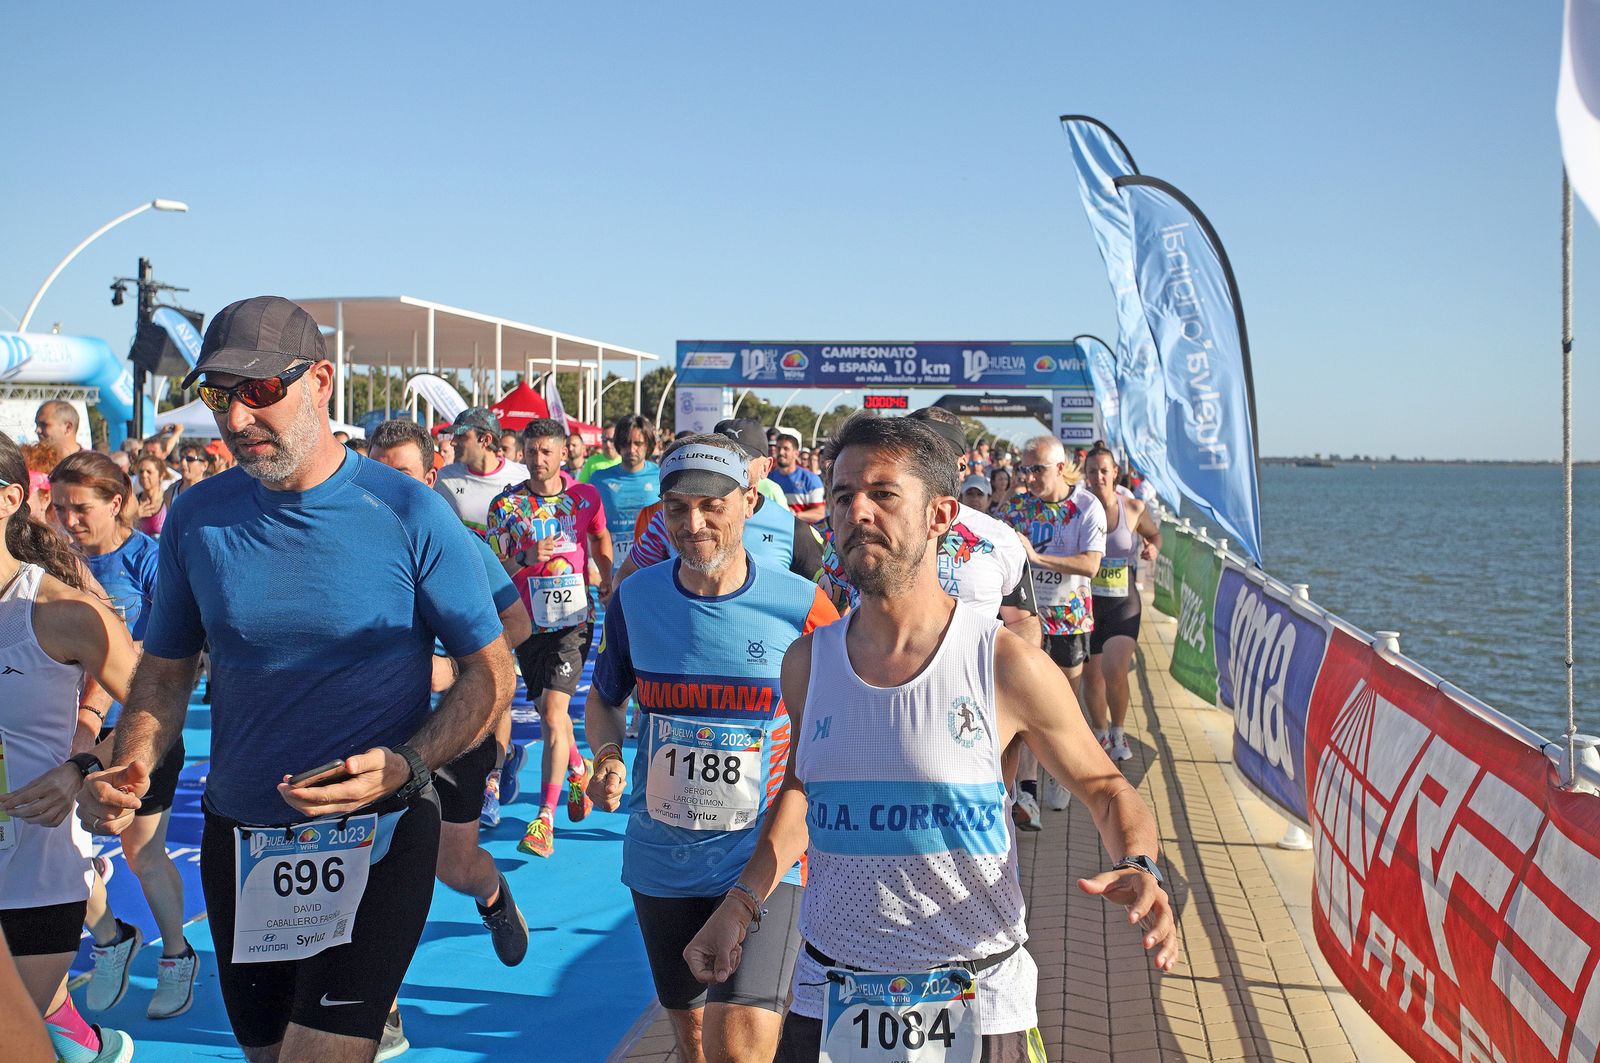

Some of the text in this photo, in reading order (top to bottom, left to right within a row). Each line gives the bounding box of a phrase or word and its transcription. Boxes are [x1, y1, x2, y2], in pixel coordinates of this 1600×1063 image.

[821, 347, 917, 358] CAMPEONATO
[820, 358, 951, 375] de ESPAÑA 10 km
[987, 356, 1026, 370] HUELVA
[1058, 358, 1087, 371] WiH
[678, 453, 730, 466] LURBEL
[543, 590, 572, 604] 792
[671, 727, 694, 740] HUELVA
[720, 733, 752, 747] 2023
[665, 748, 741, 785] 1188
[684, 786, 713, 796] SERGIO
[673, 794, 724, 807] LARGO LIMON
[655, 807, 681, 820] HYUNDAI
[686, 810, 718, 821] Syrluz
[869, 803, 997, 832] CORRALES
[328, 825, 366, 846] 2023
[273, 856, 345, 897] 696
[293, 903, 322, 914] DAVID
[266, 916, 319, 928] CABALLERO
[296, 932, 326, 947] Syrluz
[248, 943, 289, 953] HYUNDAI
[852, 1008, 956, 1050] 1084
